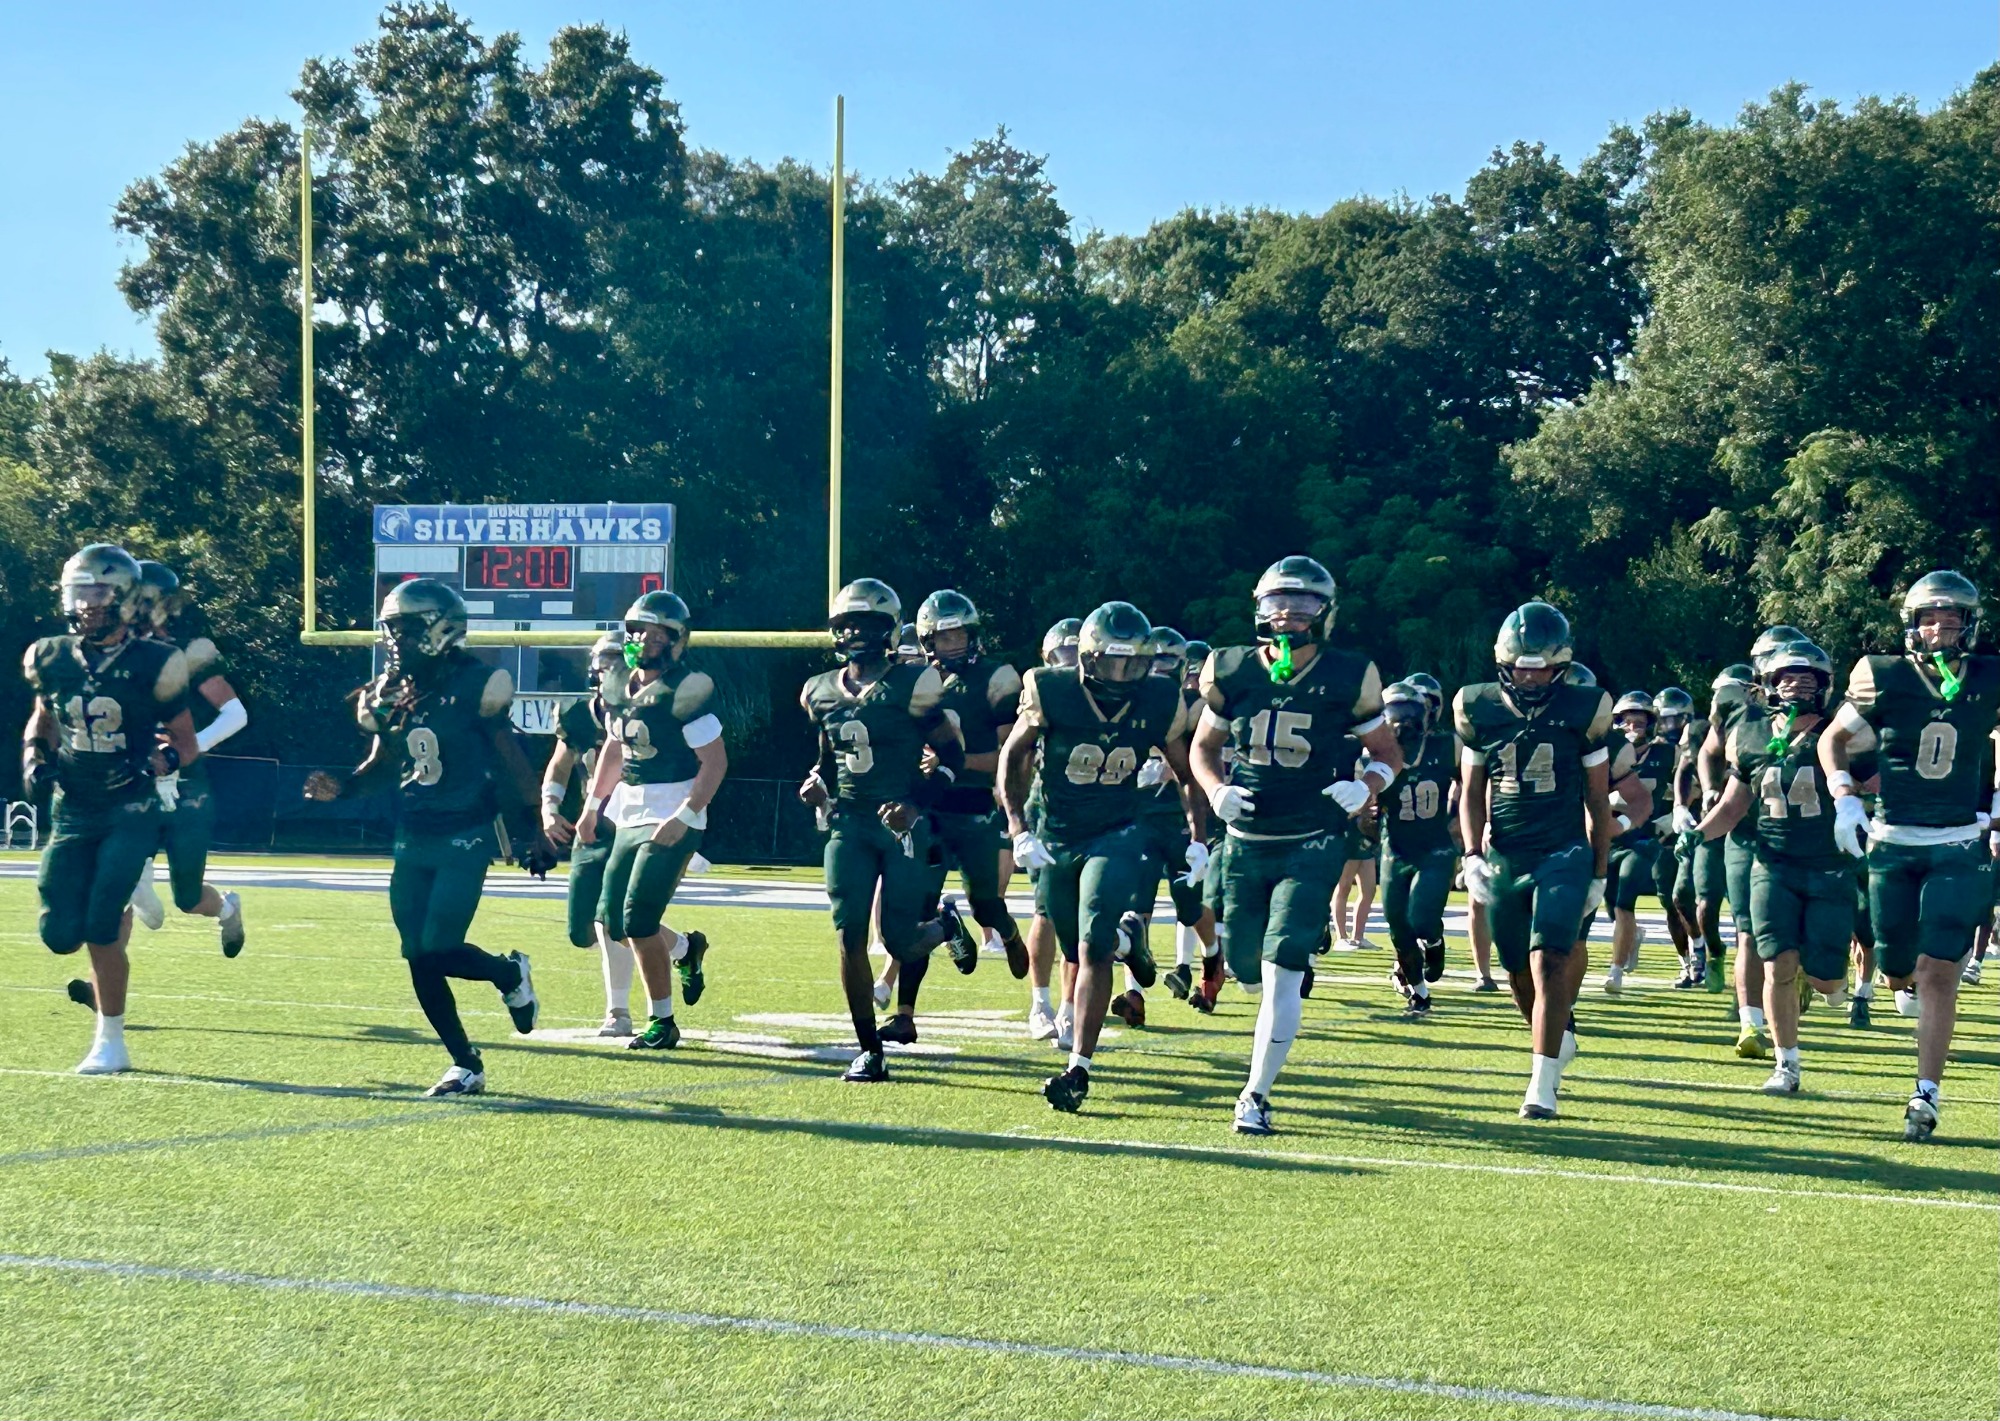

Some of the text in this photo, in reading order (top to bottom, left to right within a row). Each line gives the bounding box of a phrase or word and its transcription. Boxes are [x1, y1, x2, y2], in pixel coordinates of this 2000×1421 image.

[414, 518, 662, 541] SILVERHAWKS
[481, 546, 570, 587] 12:00
[65, 695, 126, 753] 12
[840, 720, 874, 774] 3
[1250, 709, 1312, 768] 15
[1915, 721, 1958, 780] 0
[1497, 742, 1557, 794] 14
[1760, 765, 1822, 819] 44
[1399, 779, 1440, 821] 10
